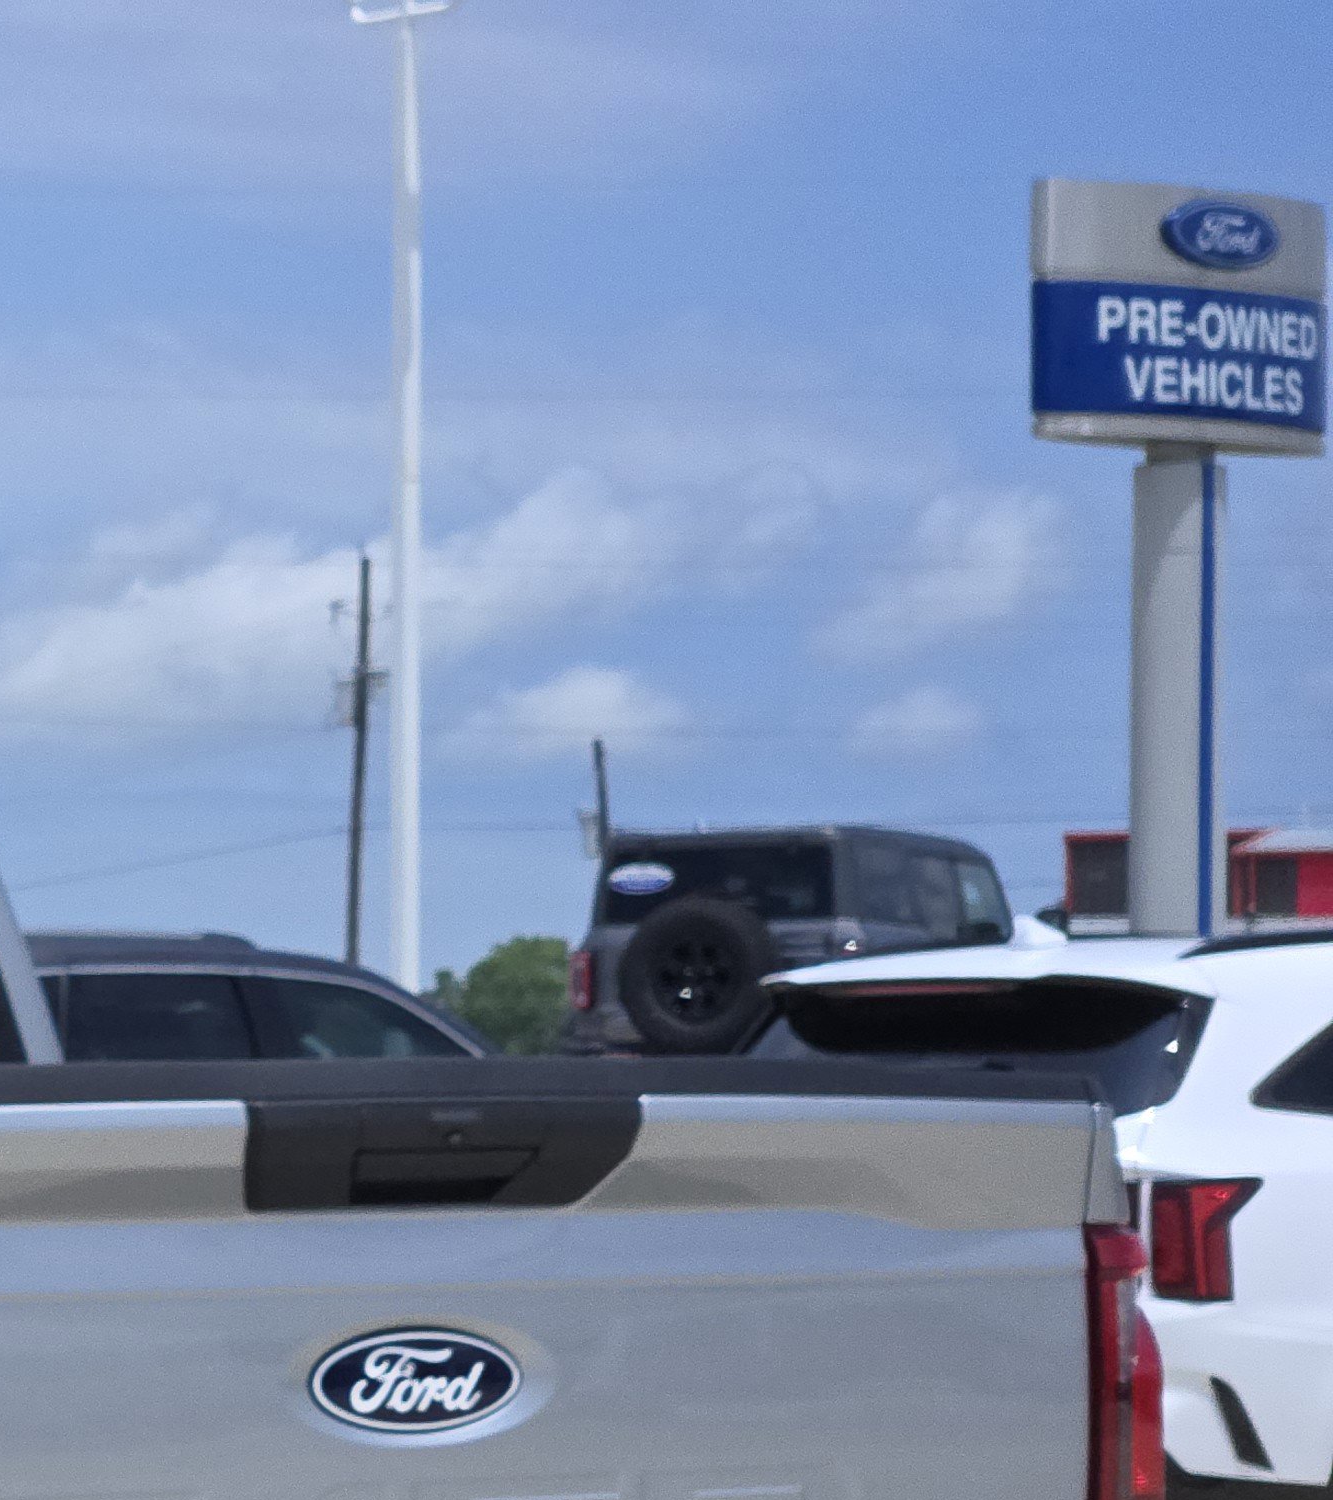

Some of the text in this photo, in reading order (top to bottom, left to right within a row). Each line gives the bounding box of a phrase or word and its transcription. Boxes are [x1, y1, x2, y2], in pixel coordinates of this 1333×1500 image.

[1196, 212, 1262, 255] Ford
[1096, 296, 1317, 360] PRE-OWNED
[1124, 355, 1304, 415] VEHICLES
[350, 1346, 485, 1414] Ford
